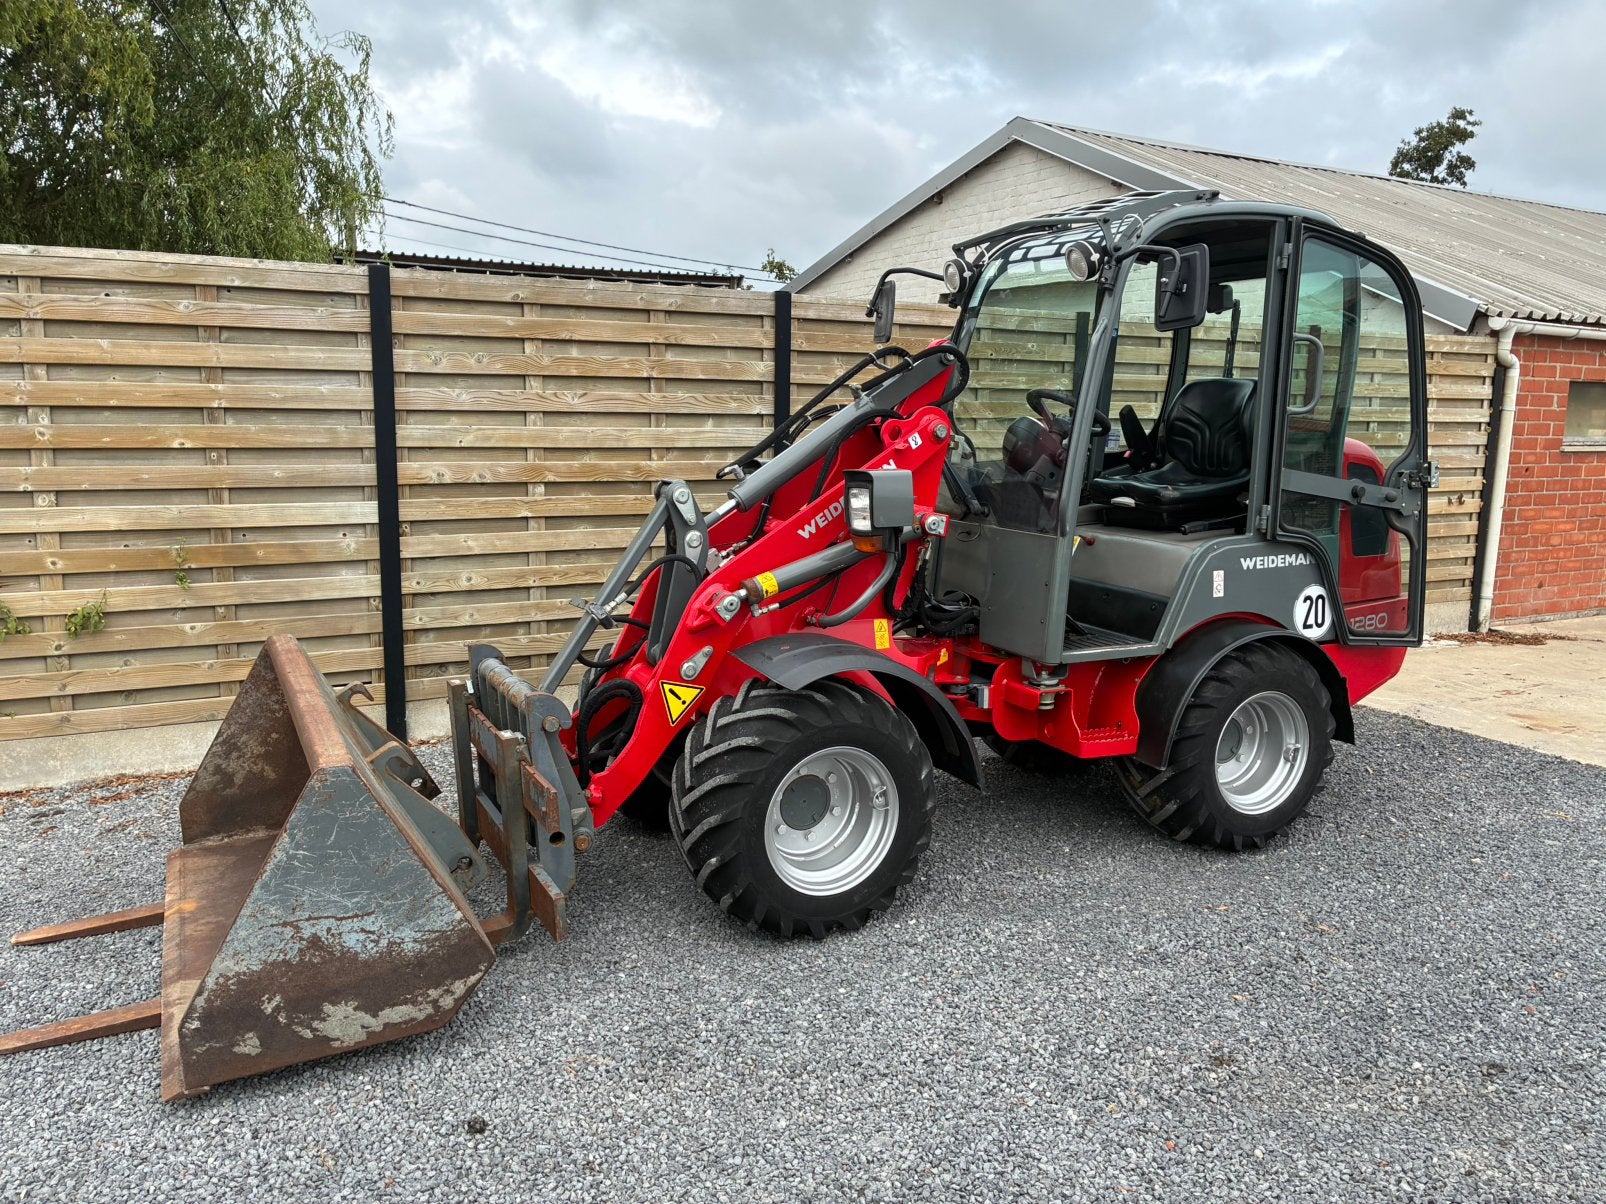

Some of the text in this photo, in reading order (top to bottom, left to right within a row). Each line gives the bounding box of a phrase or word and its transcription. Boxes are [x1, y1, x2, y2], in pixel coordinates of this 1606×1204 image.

[797, 496, 845, 539] WEID
[1302, 594, 1326, 630] 20
[1350, 613, 1388, 631] 1280
